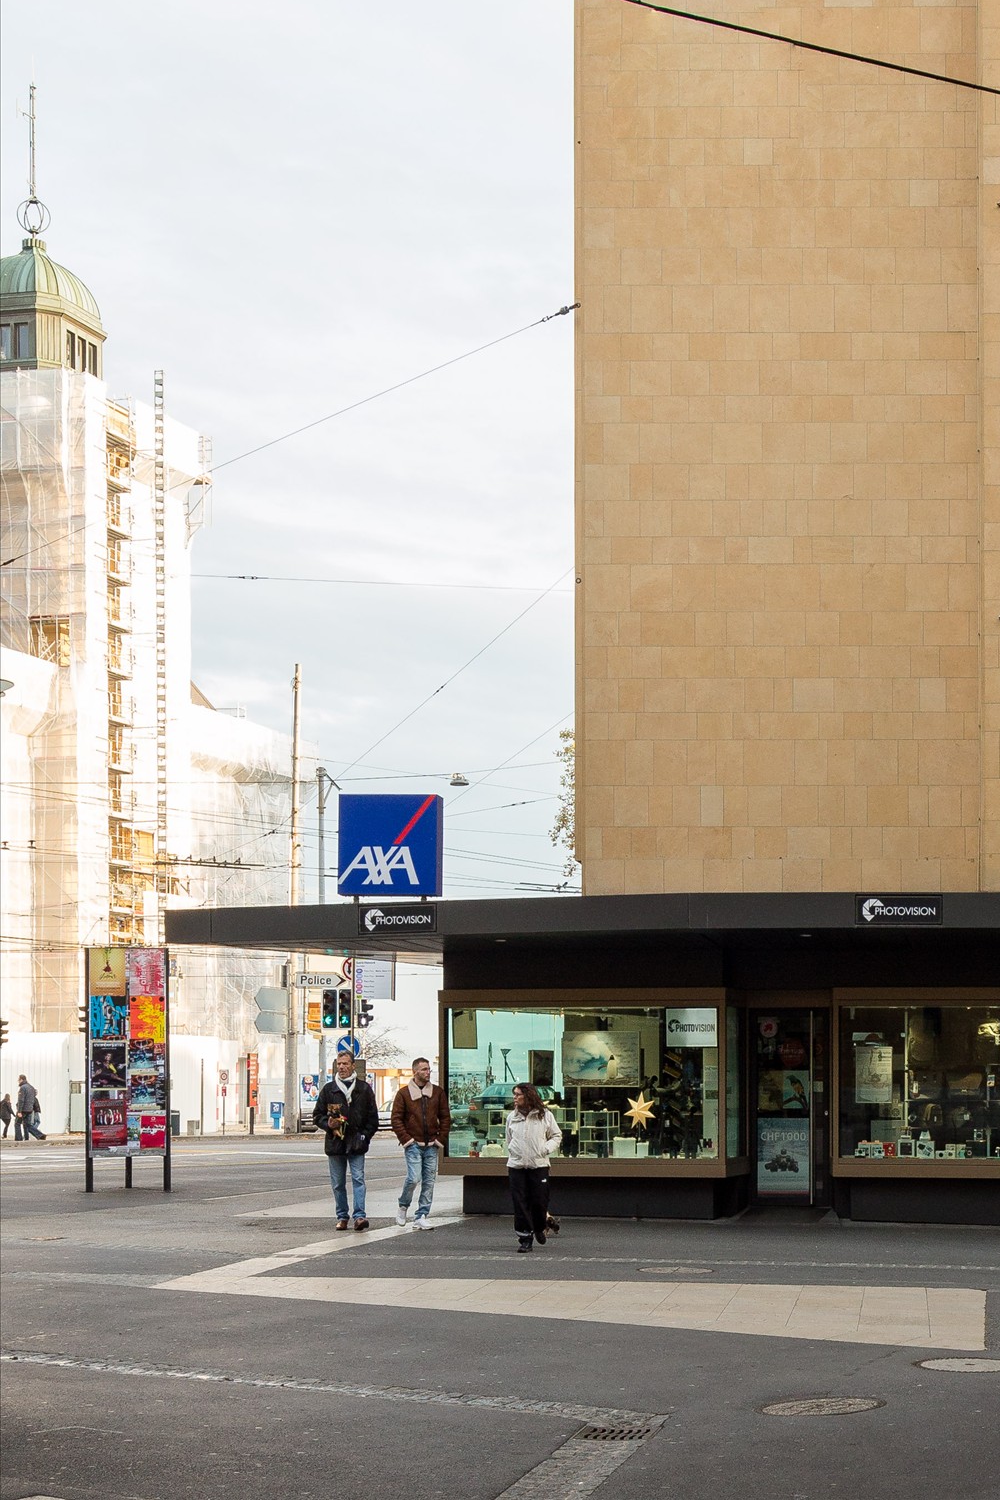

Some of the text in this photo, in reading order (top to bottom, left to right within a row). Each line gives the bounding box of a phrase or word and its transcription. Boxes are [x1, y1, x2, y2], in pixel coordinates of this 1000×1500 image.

[338, 846, 420, 885] AXA
[874, 906, 936, 916] PHOTOVISION
[375, 914, 431, 925] PHOTOVISION
[300, 975, 332, 985] Police
[675, 1023, 716, 1033] PHOTOVISION
